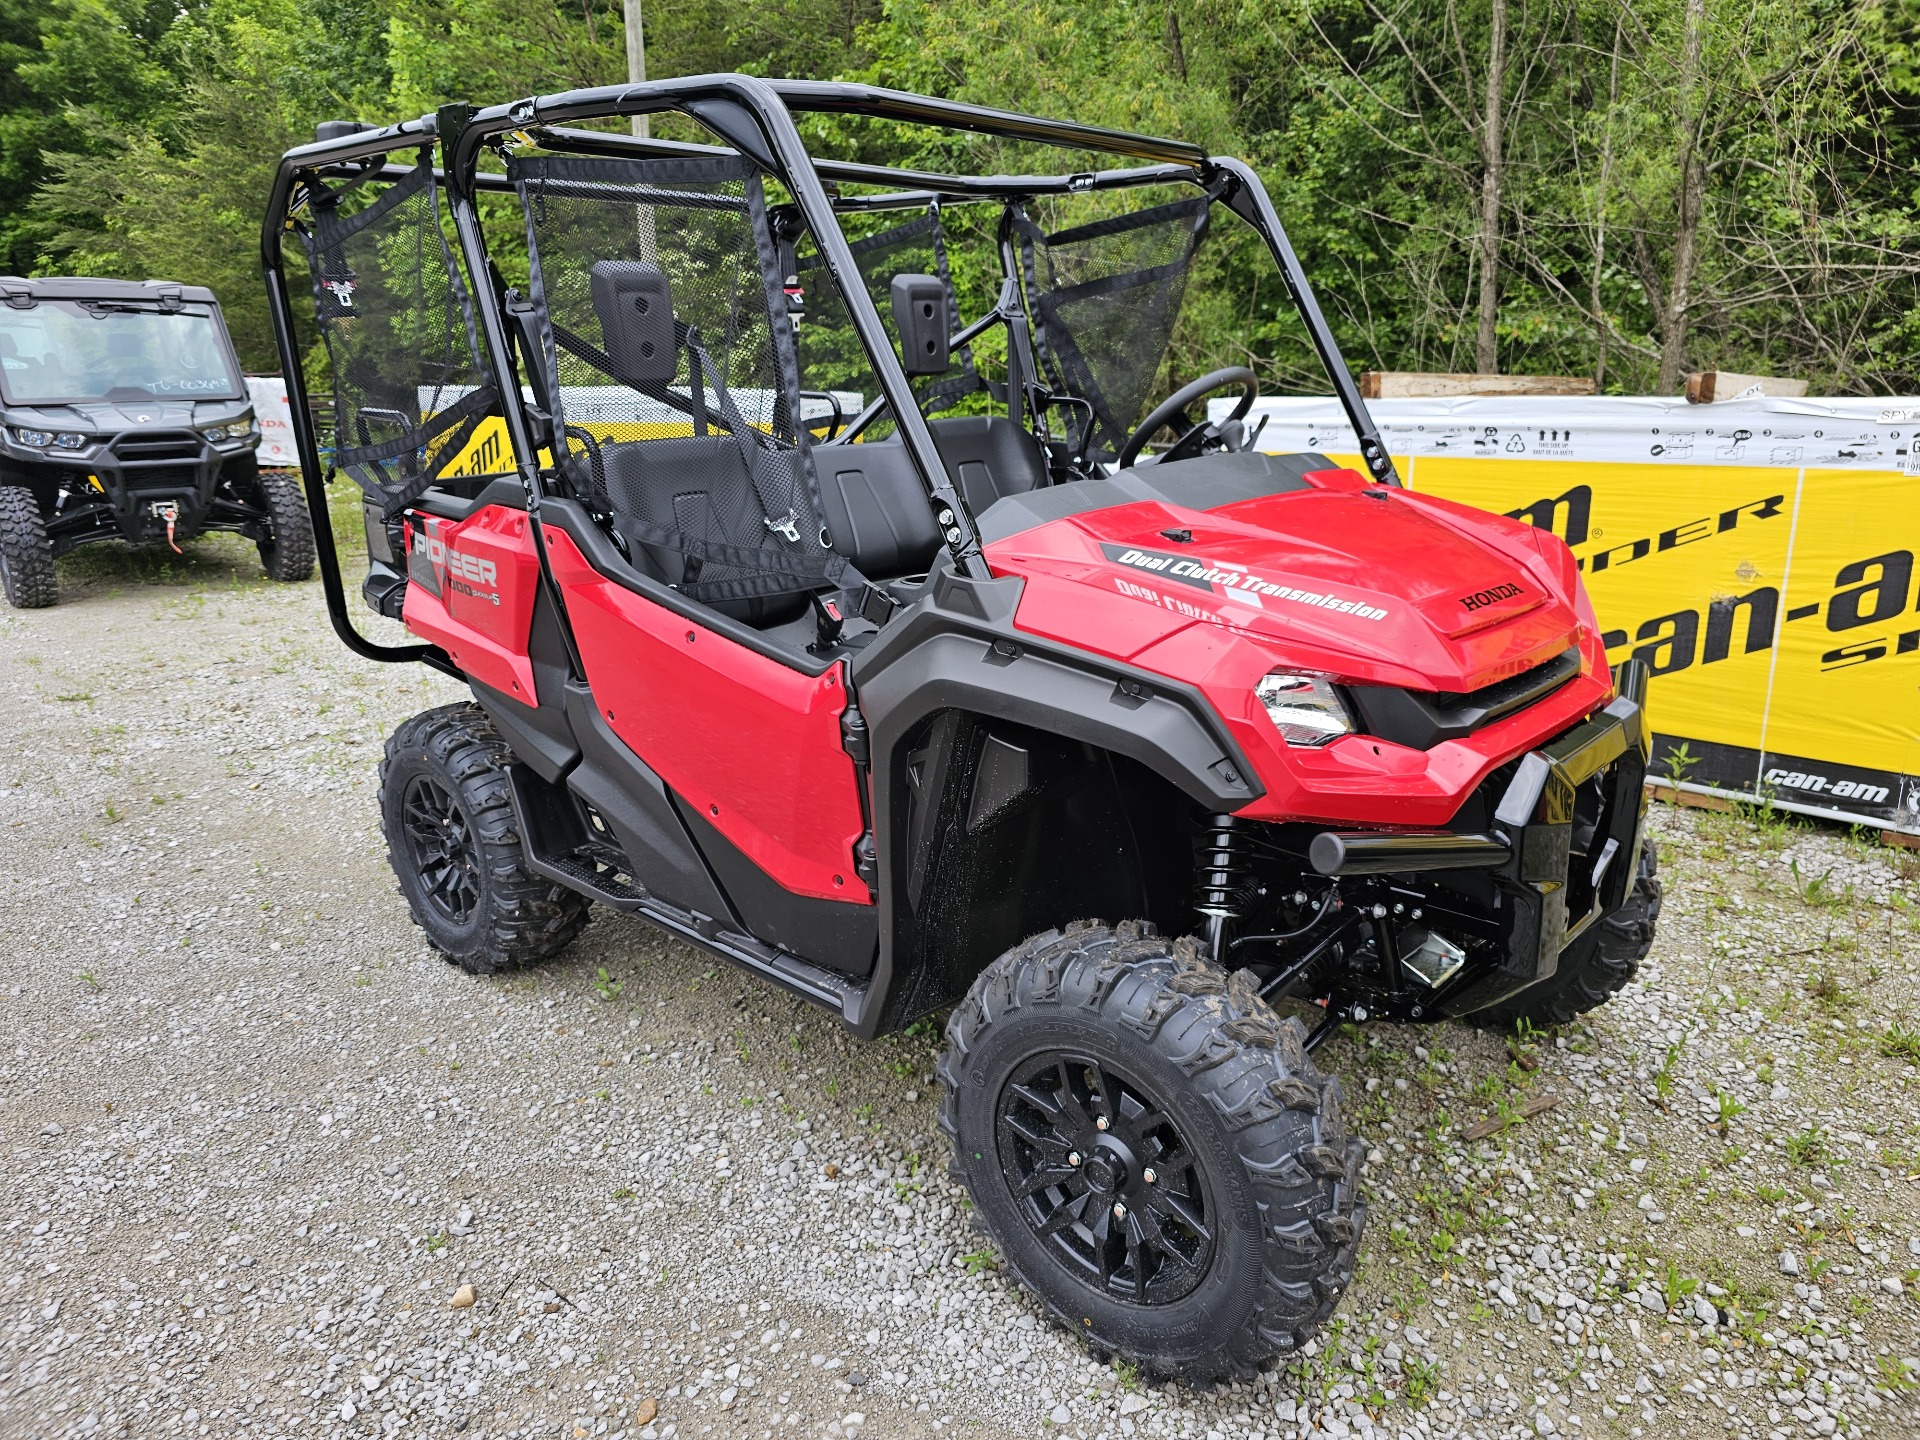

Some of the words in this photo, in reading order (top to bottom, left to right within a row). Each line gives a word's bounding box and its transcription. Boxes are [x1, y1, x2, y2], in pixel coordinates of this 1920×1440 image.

[414, 531, 498, 588] PIONEER
[1577, 494, 1785, 574] DER
[1118, 550, 1170, 571] Dual
[1169, 560, 1241, 587] Clutch
[1240, 575, 1389, 621] Transmission
[1458, 582, 1524, 612] HONDA
[1764, 768, 1890, 803] can-am
